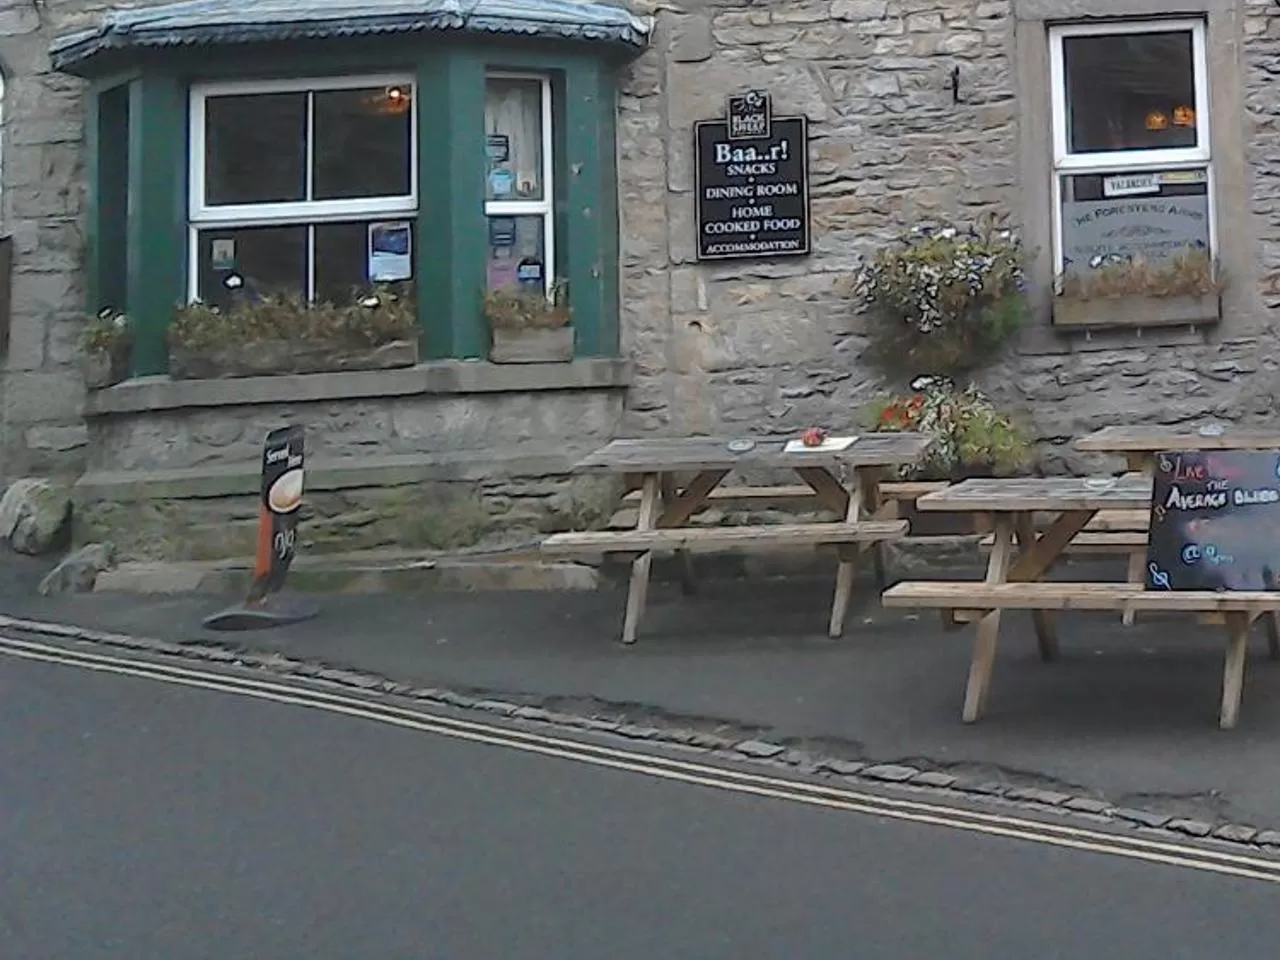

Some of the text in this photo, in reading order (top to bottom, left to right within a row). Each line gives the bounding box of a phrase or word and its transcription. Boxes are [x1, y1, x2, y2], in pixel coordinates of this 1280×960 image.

[727, 163, 776, 176] SNACKS
[706, 183, 798, 200] DINING ROOM
[732, 205, 773, 218] HOME
[705, 218, 801, 234] COOKED FOOD
[706, 240, 800, 254] ACCOMMODATION
[1166, 486, 1227, 510] AVERAGE
